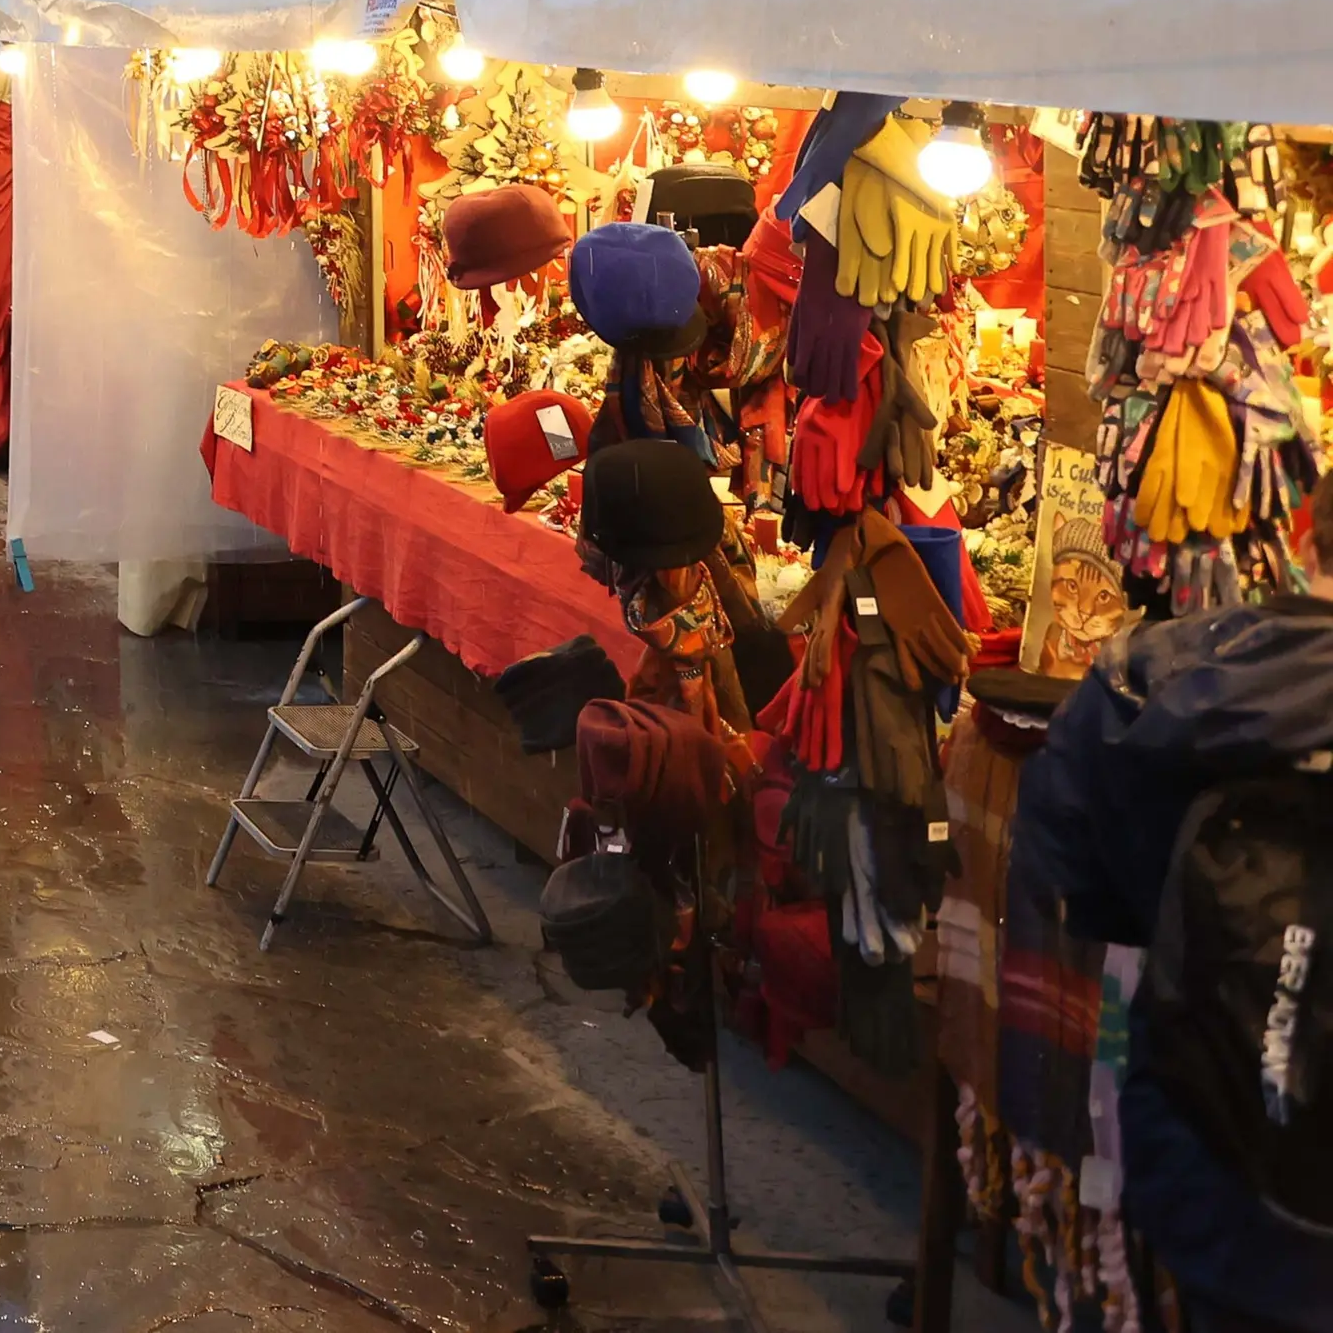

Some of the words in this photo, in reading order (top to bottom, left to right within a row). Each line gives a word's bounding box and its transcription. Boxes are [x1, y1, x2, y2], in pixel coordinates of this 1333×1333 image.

[1051, 458, 1063, 478] A
[1047, 483, 1059, 498] is
[1059, 491, 1075, 510] the
[1077, 488, 1104, 516] best
